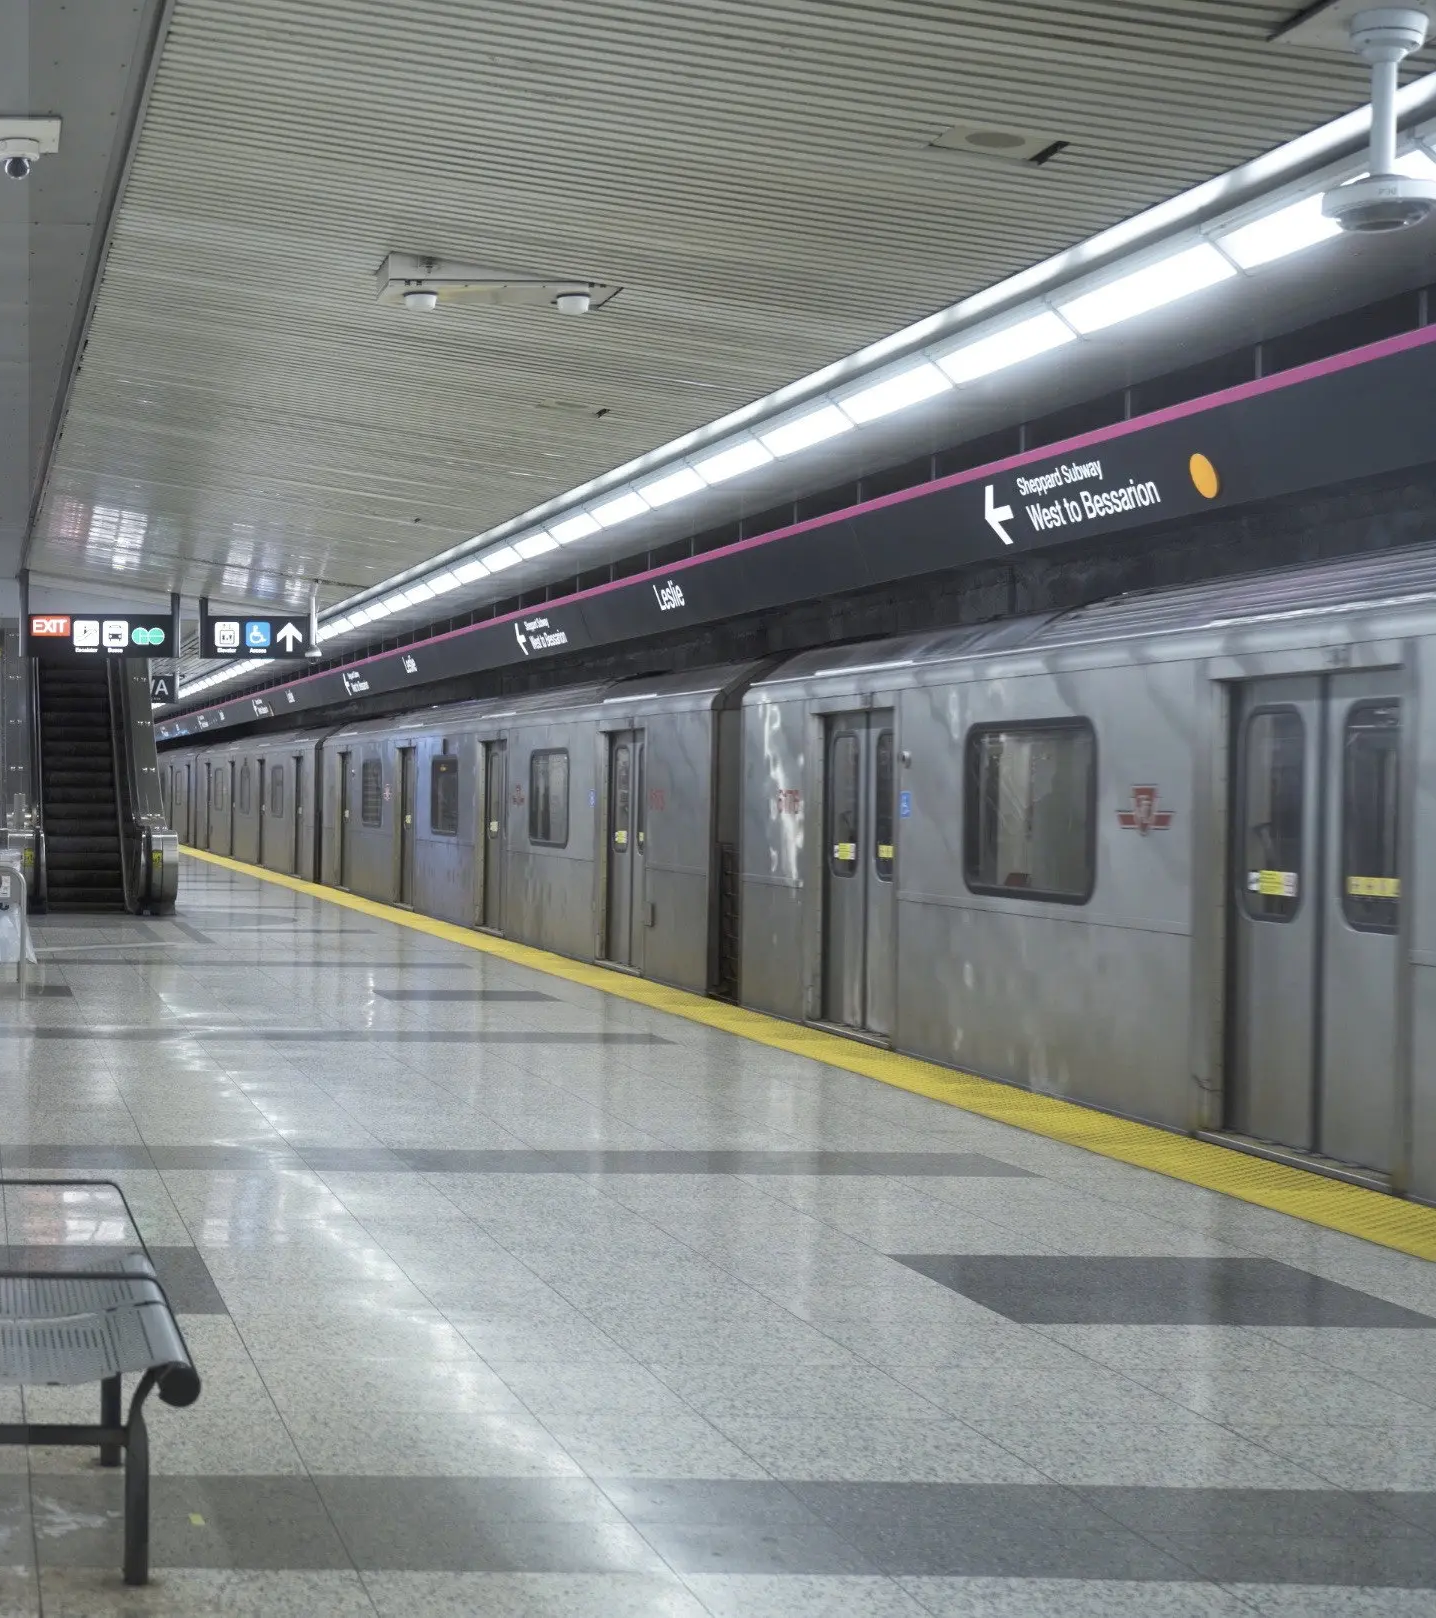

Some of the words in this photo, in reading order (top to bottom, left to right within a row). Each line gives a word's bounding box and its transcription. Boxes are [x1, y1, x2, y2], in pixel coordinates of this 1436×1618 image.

[1017, 467, 1063, 496] Sheppard
[1061, 460, 1103, 484] Subway
[1025, 500, 1067, 532] West
[1063, 497, 1082, 523] to
[1079, 479, 1161, 519] Bessarion
[652, 580, 685, 611] Leslie
[32, 619, 67, 633] EXIT
